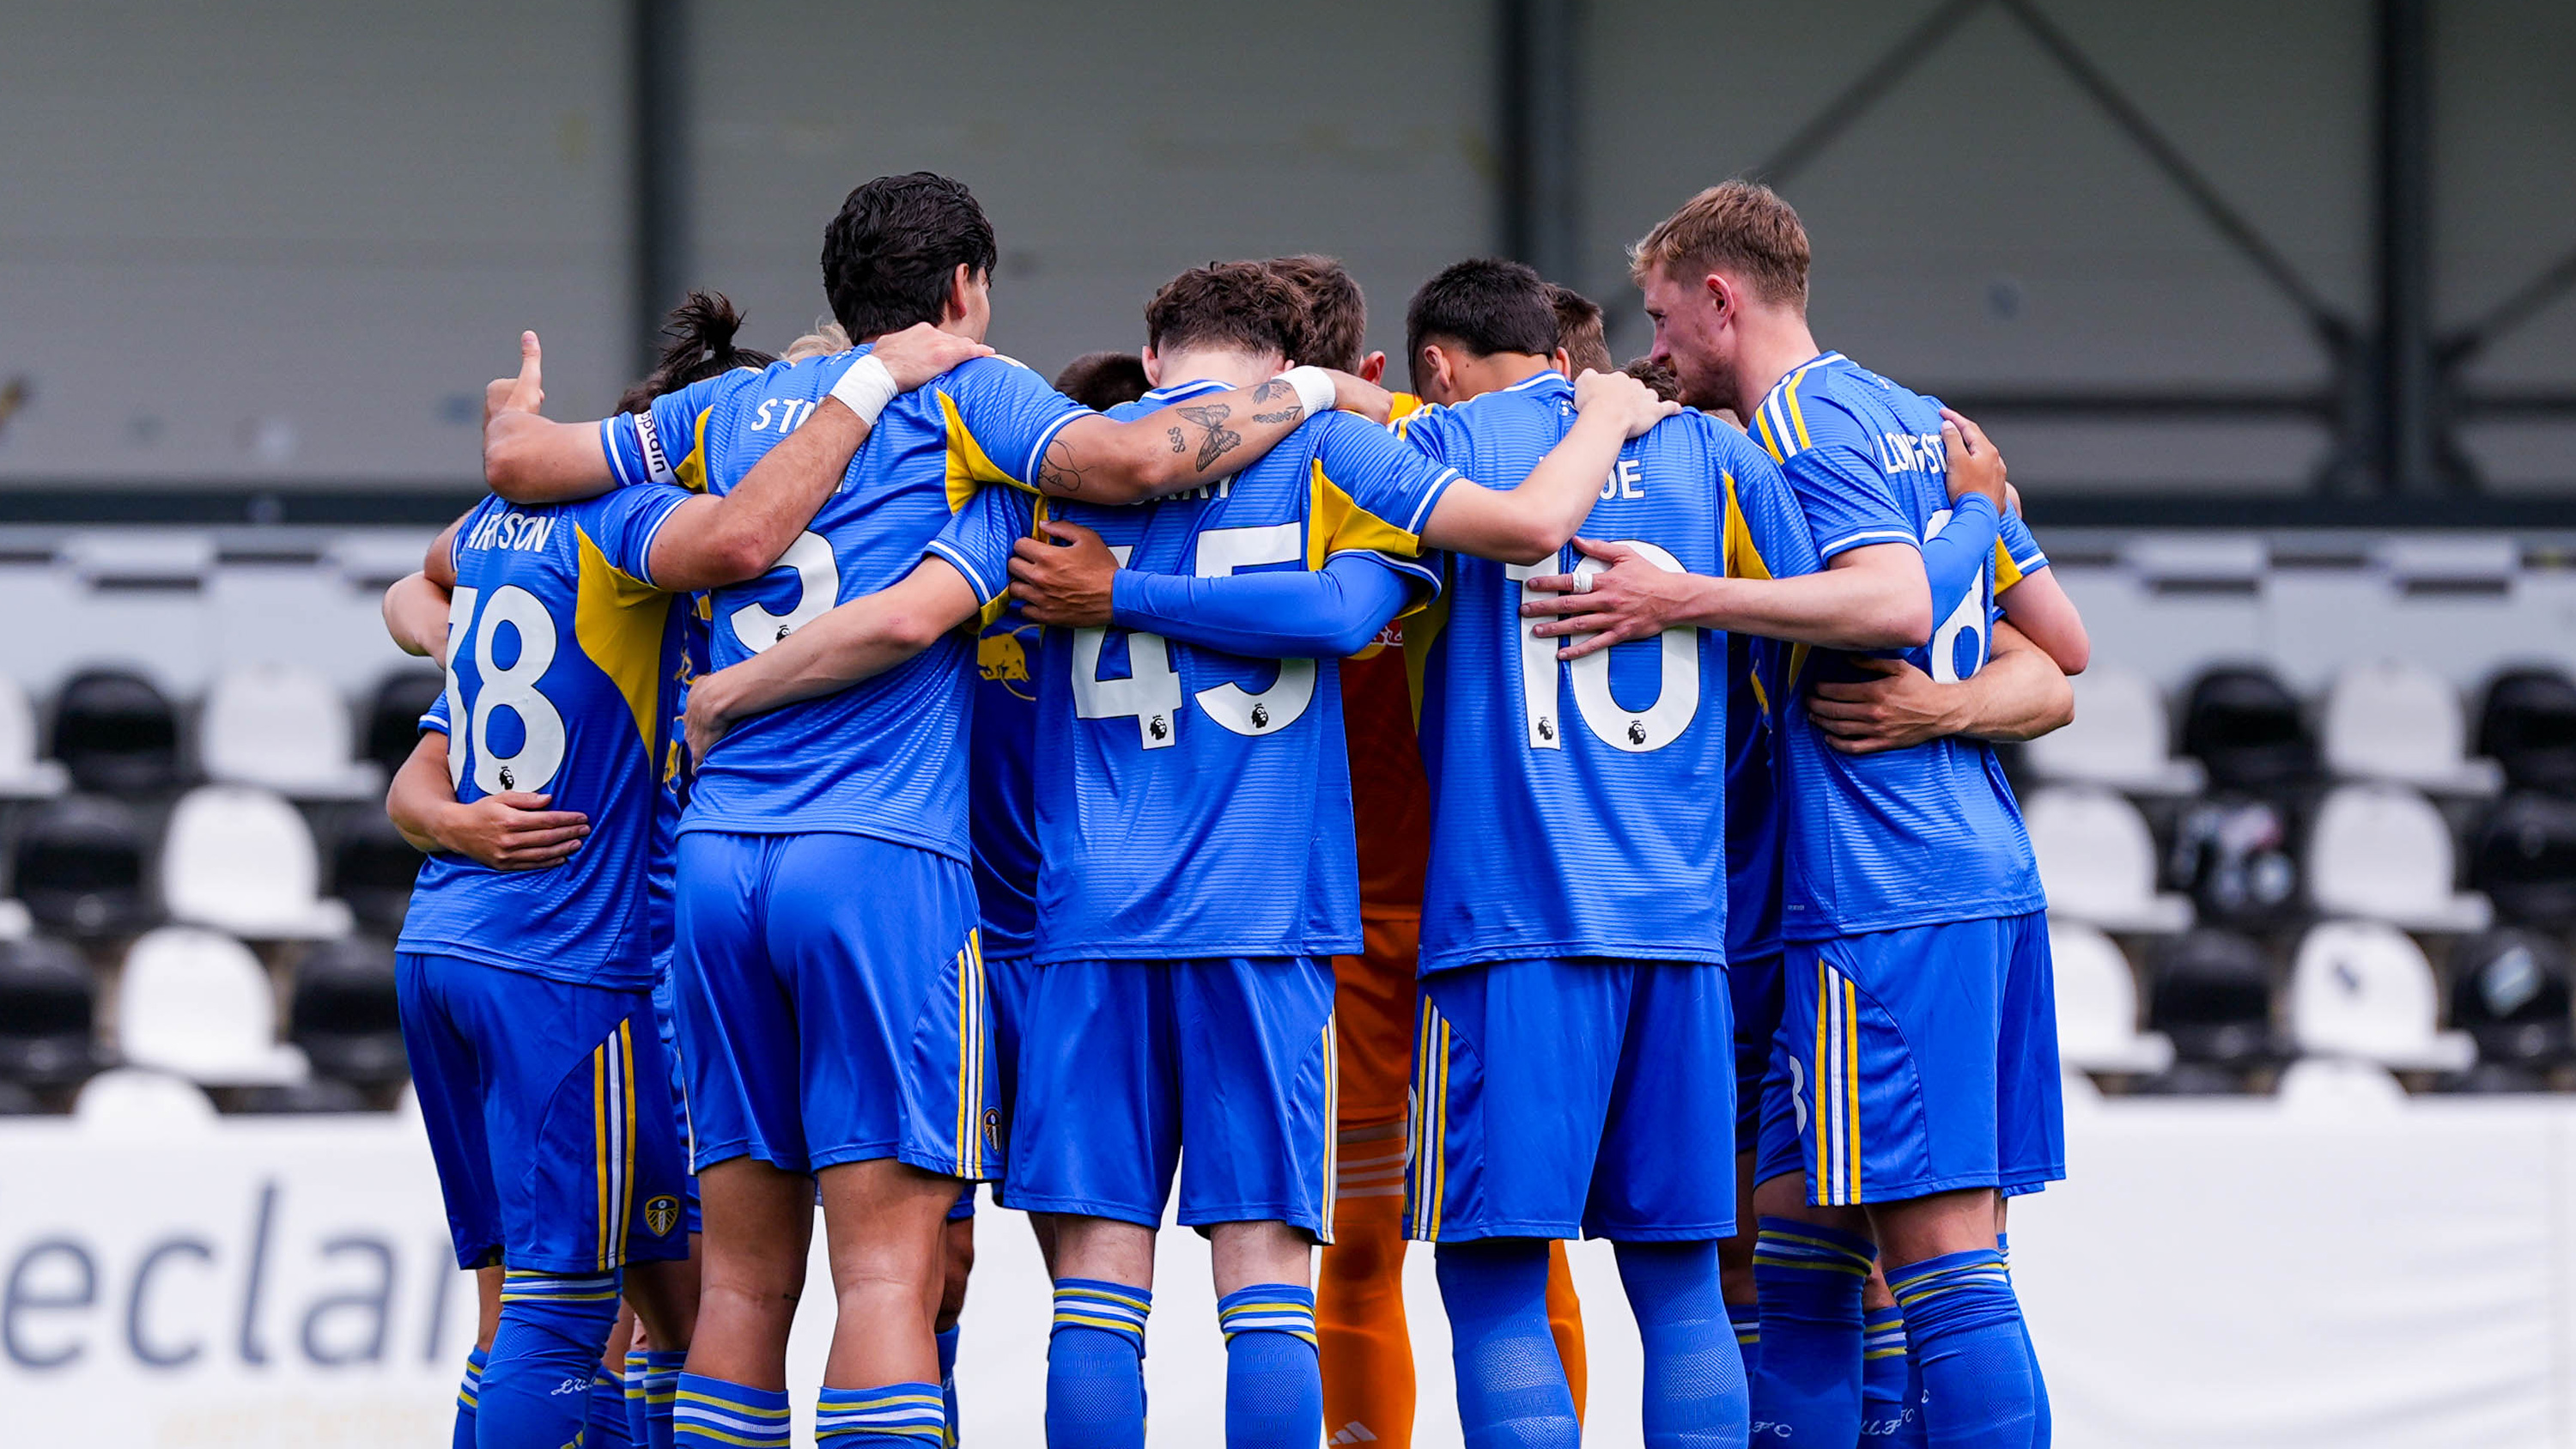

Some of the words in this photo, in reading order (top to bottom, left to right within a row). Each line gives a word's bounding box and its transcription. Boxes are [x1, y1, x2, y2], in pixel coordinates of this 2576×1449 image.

[446, 584, 566, 795] 38
[1072, 521, 1316, 750] 45
[1504, 539, 1700, 753] 10
